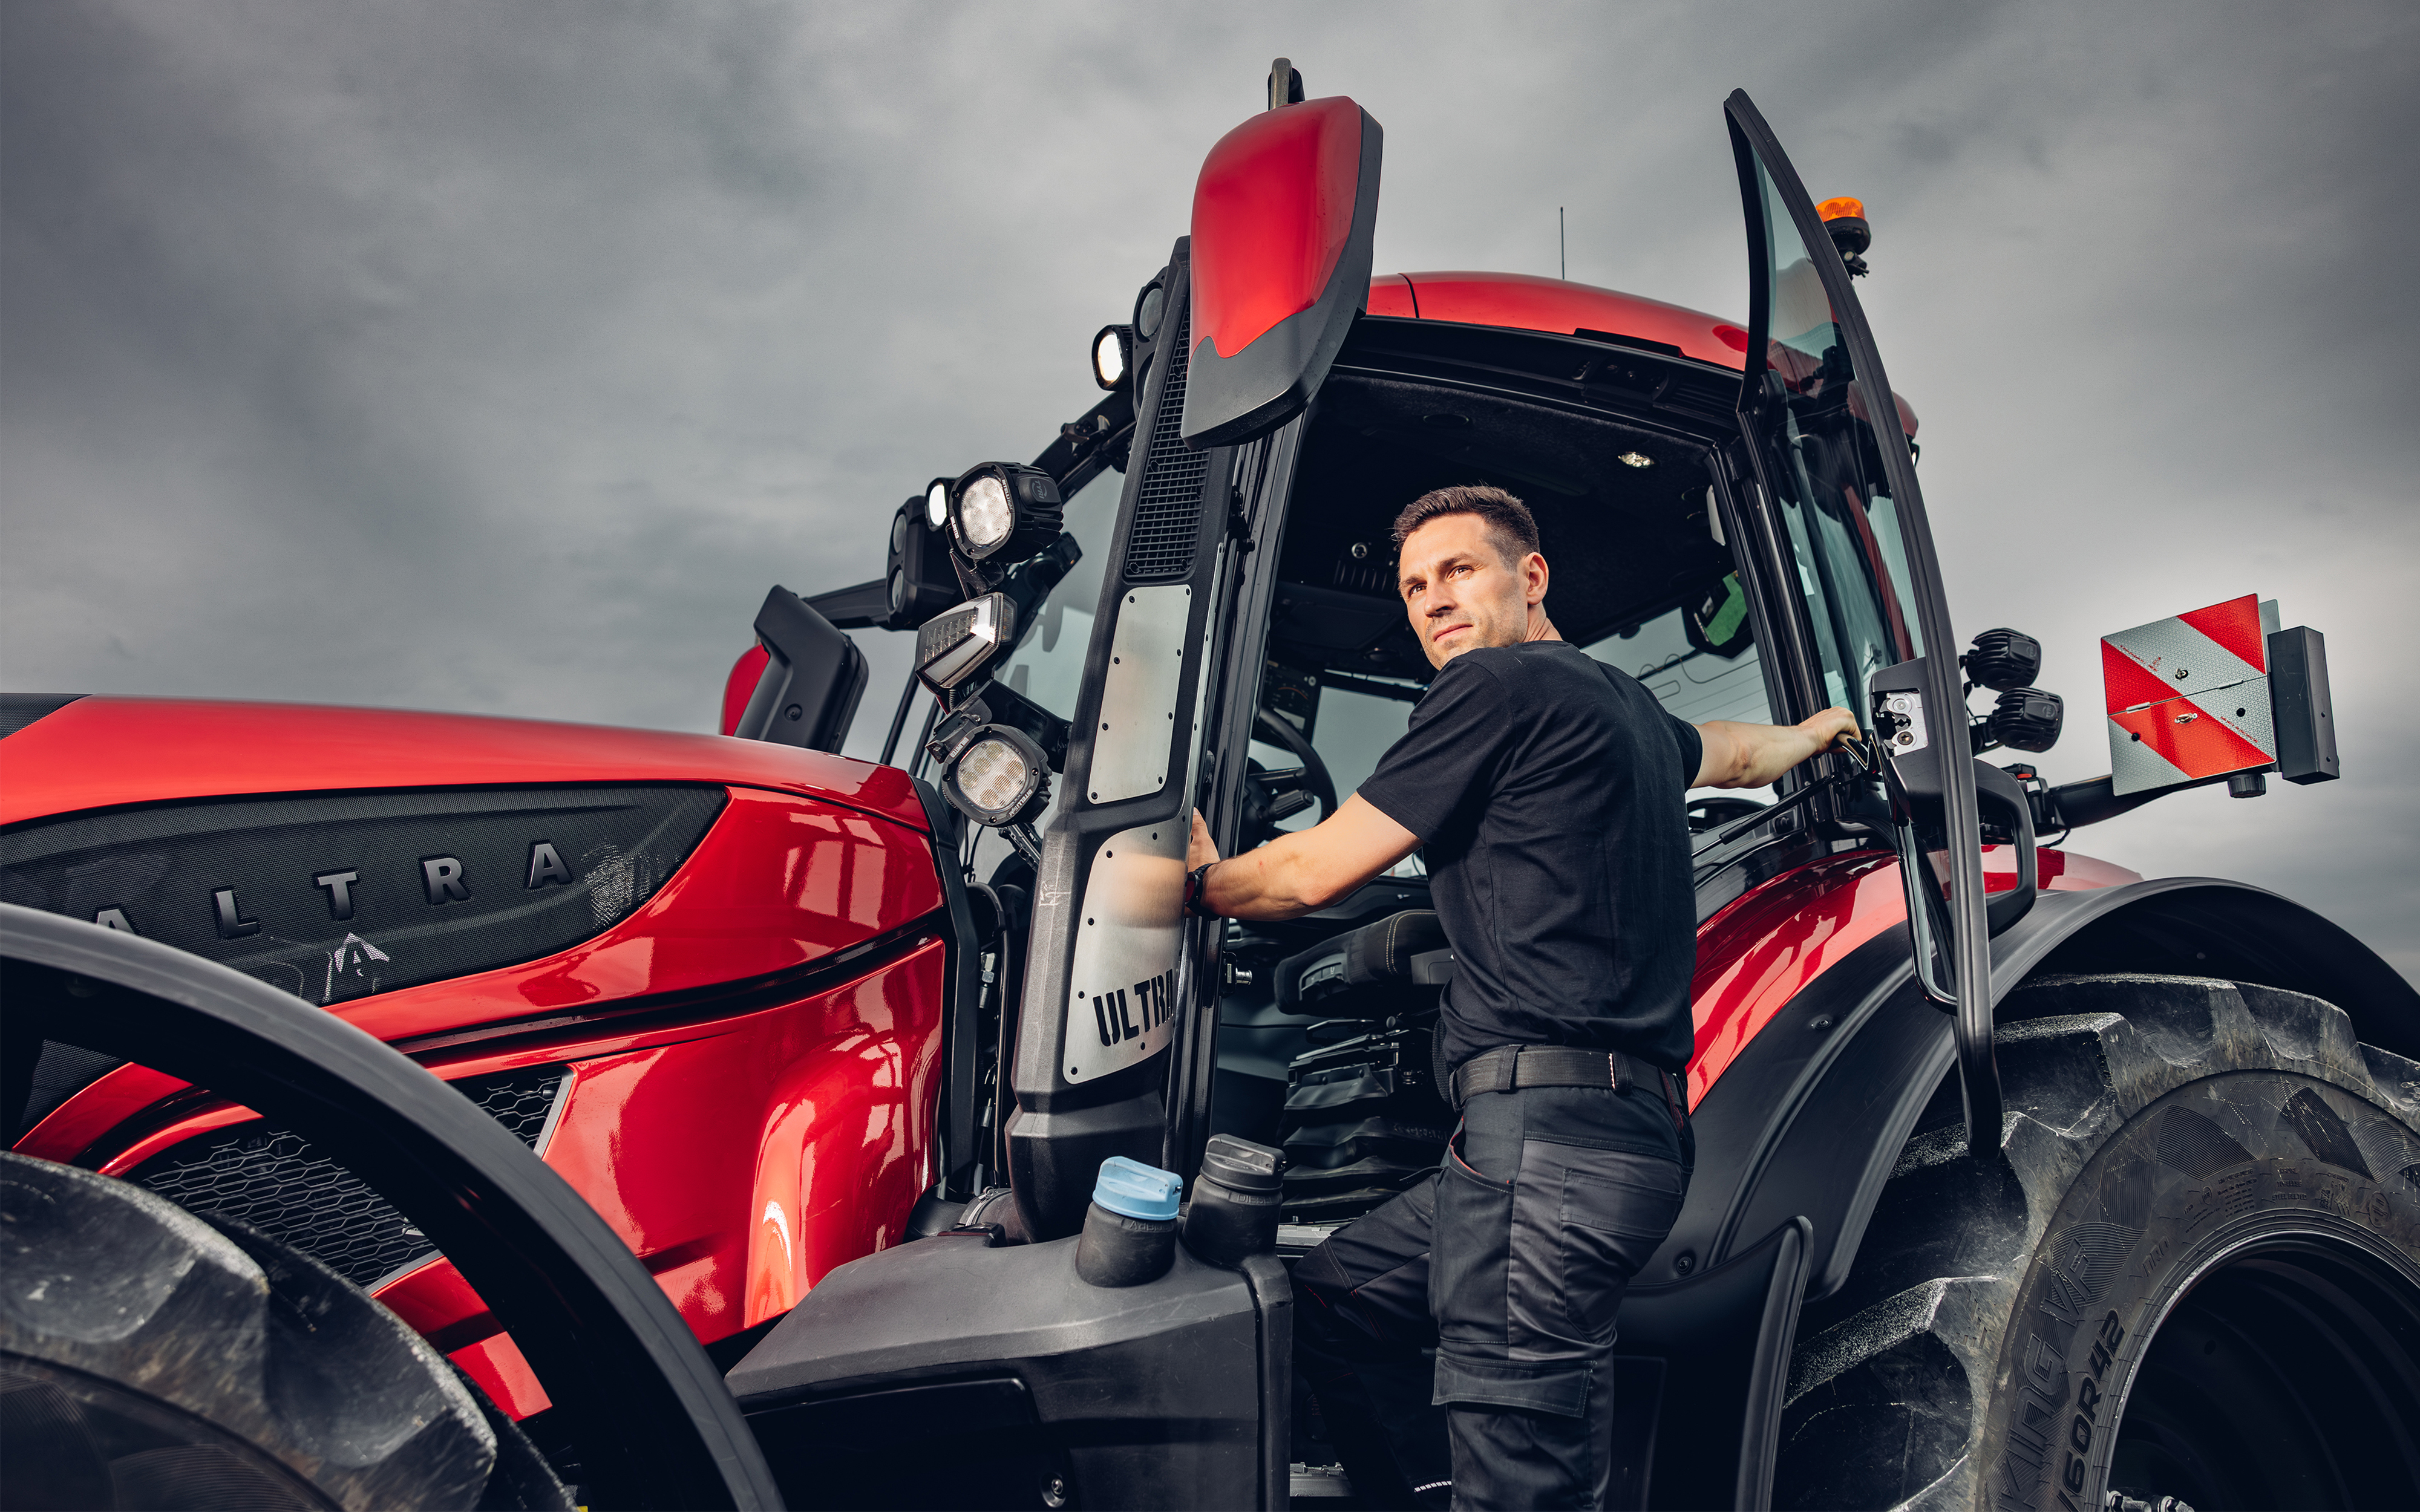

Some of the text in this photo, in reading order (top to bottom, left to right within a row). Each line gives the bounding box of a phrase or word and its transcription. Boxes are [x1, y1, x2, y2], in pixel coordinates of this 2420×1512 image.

[1035, 480, 1045, 499] TYRI
[950, 737, 969, 758] UNLIMITED
[1237, 1194, 1274, 1204] DIESEL
[1998, 1237, 2092, 1512] KING VF
